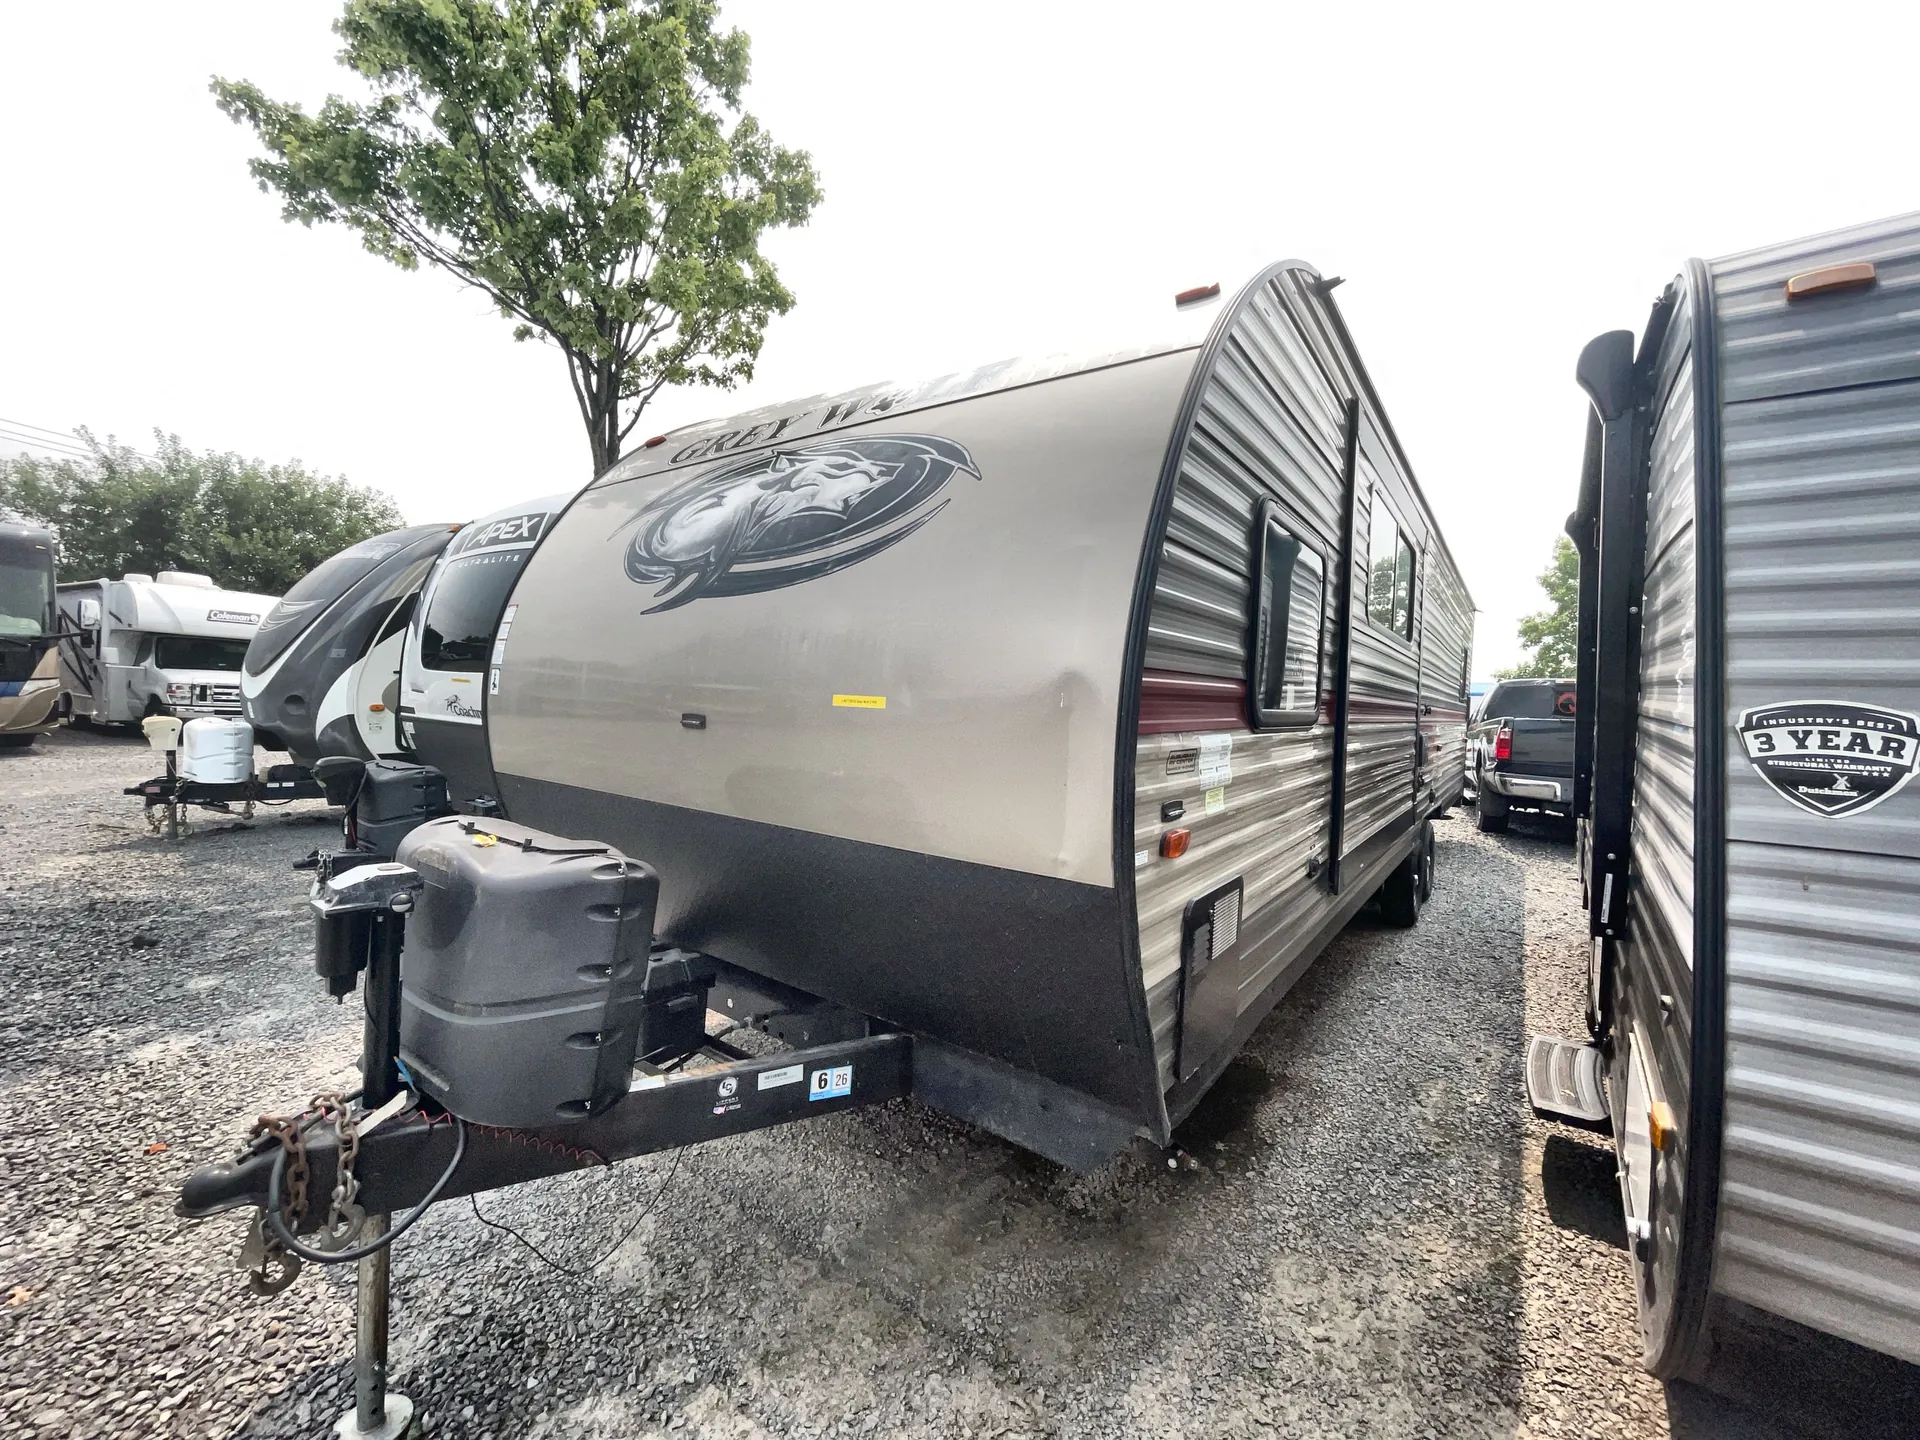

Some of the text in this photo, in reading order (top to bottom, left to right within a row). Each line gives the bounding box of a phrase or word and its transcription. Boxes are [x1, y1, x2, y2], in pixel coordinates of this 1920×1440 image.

[668, 410, 815, 465] GREY
[467, 516, 541, 547] APEX
[210, 610, 250, 622] Coleman
[453, 705, 484, 719] Coachm
[1763, 717, 1896, 731] INDUSTRY'S BEST
[1753, 729, 1907, 760] 3 YEAR
[1767, 759, 1893, 773] STRUCTURAL WARRANTY
[1797, 785, 1858, 797] Dutchmen
[818, 1072, 848, 1090] 6 26
